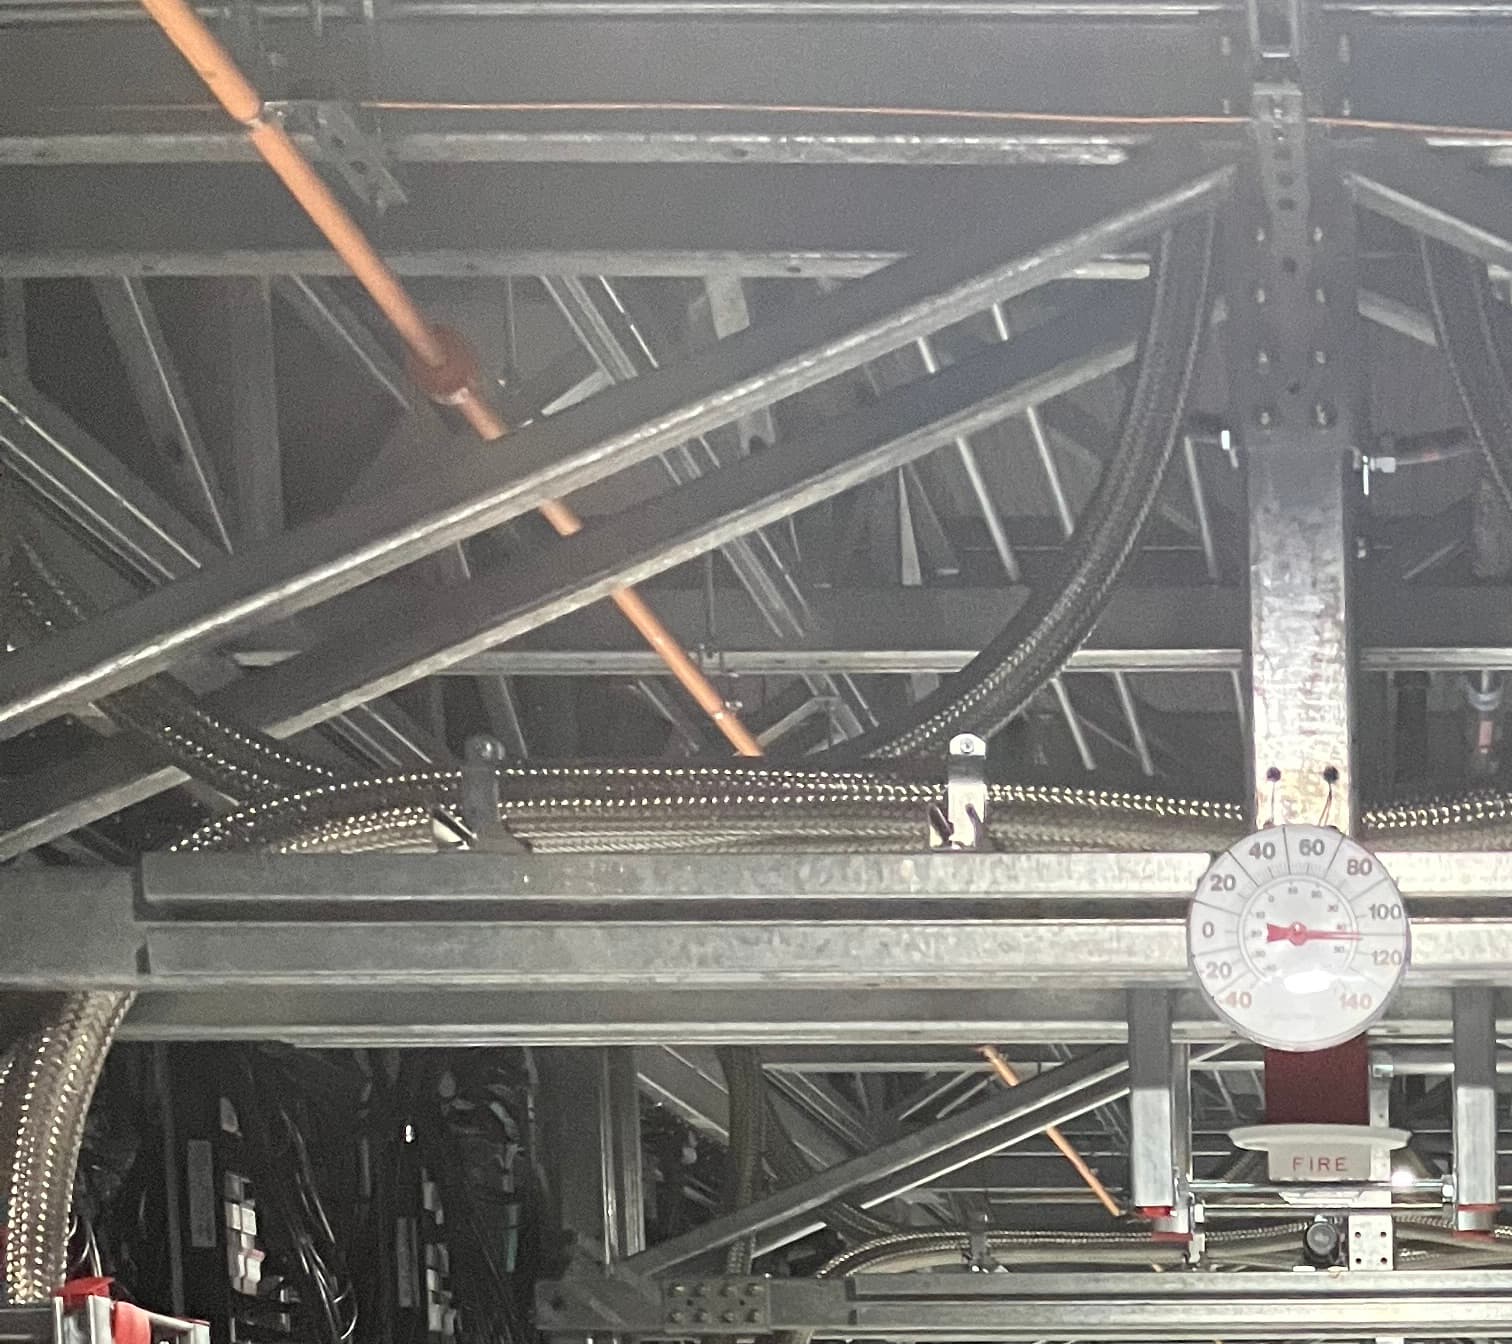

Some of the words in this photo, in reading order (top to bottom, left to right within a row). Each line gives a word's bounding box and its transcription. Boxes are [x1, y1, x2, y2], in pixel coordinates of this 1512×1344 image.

[1249, 842, 1276, 860] 40
[1300, 839, 1325, 857] 60
[1347, 858, 1373, 876] 80
[1210, 874, 1236, 892] 20
[1369, 904, 1401, 920] 100
[1202, 921, 1215, 938] 0
[1373, 950, 1402, 966] 120
[1339, 993, 1372, 1010] 140
[1292, 1156, 1349, 1173] FIRE
